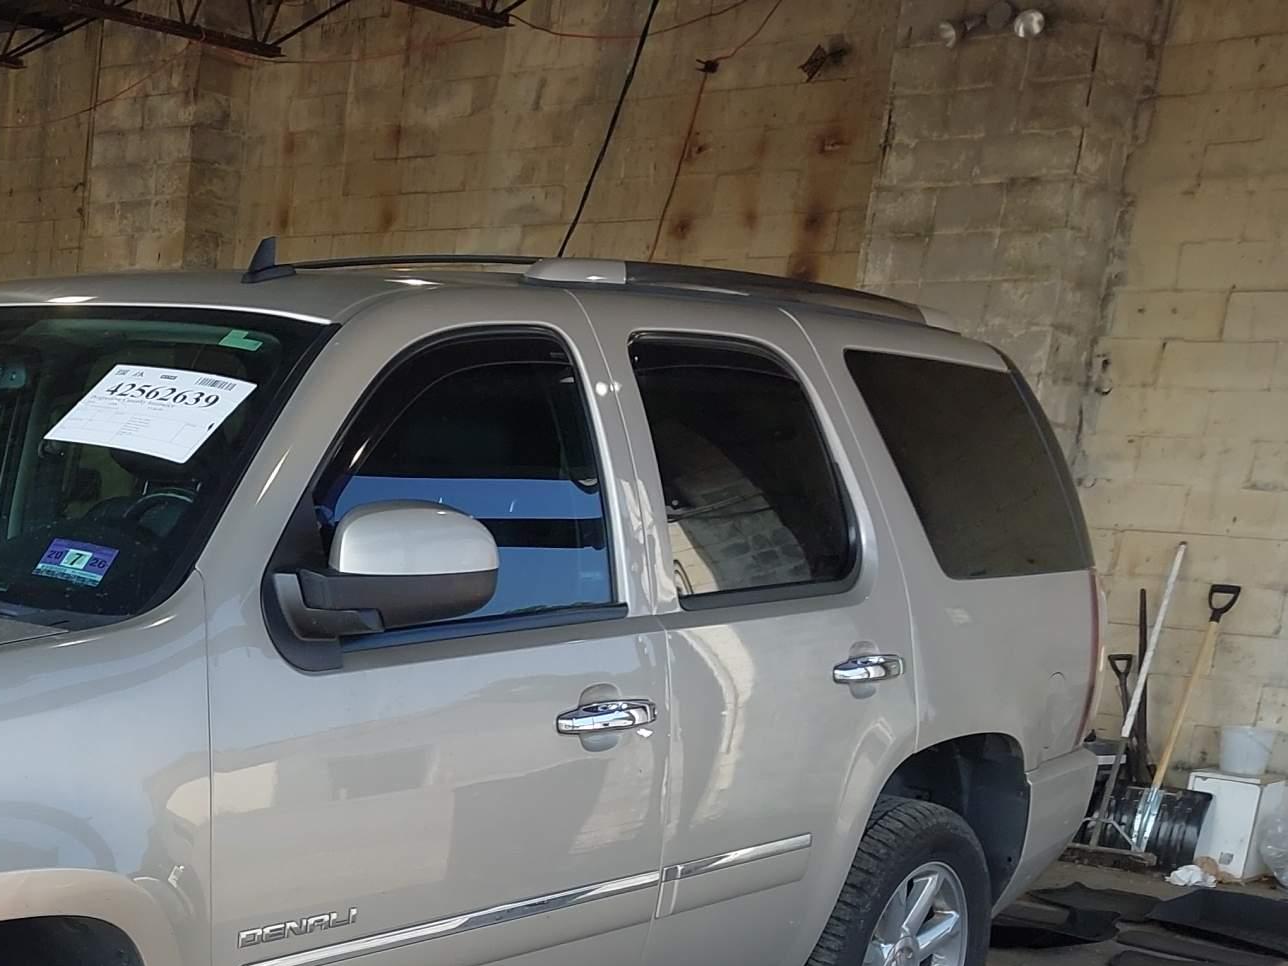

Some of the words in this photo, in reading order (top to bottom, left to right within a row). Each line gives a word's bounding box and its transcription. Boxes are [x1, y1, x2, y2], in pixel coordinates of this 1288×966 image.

[106, 382, 220, 408] 42562639
[47, 550, 64, 560] 20
[69, 552, 84, 566] 7
[89, 557, 106, 569] 26
[236, 906, 358, 949] DENALI
